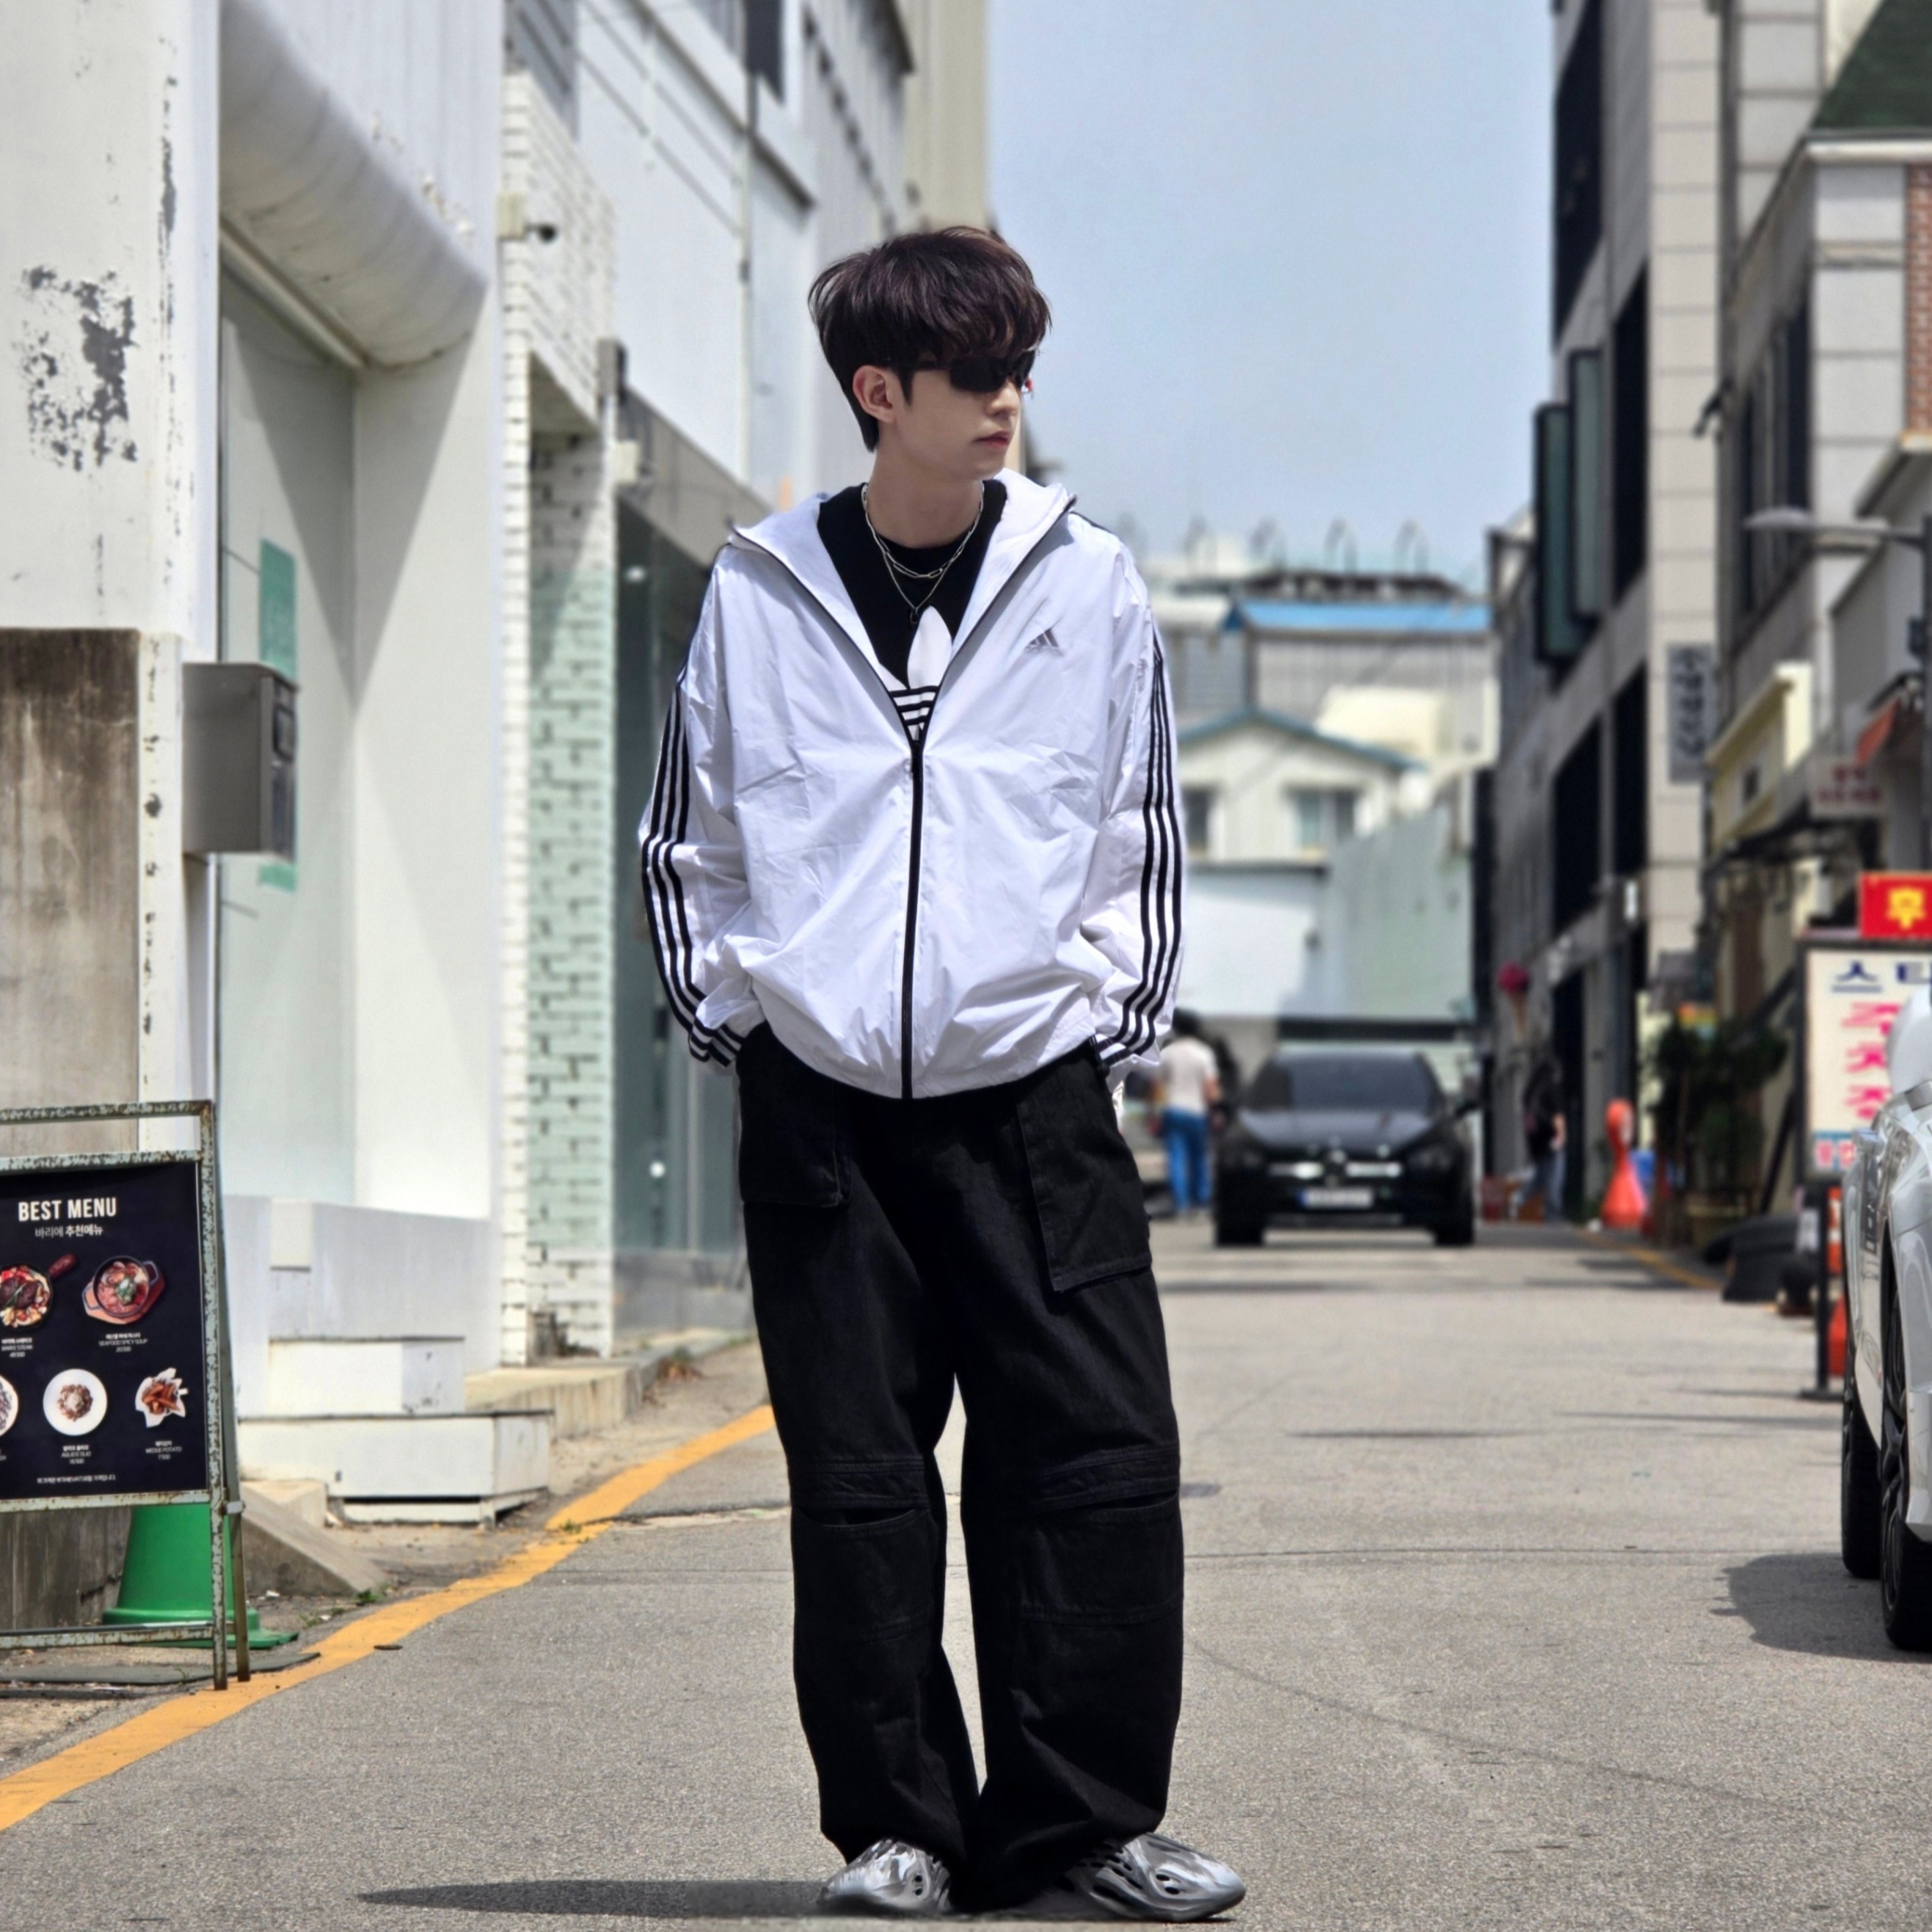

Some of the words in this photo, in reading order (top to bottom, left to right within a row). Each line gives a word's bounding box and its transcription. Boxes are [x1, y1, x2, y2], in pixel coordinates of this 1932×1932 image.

[18, 1200, 62, 1222] BEST
[67, 1196, 117, 1219] MENU
[34, 1225, 64, 1239] 바리에
[65, 1222, 103, 1238] 추천메뉴
